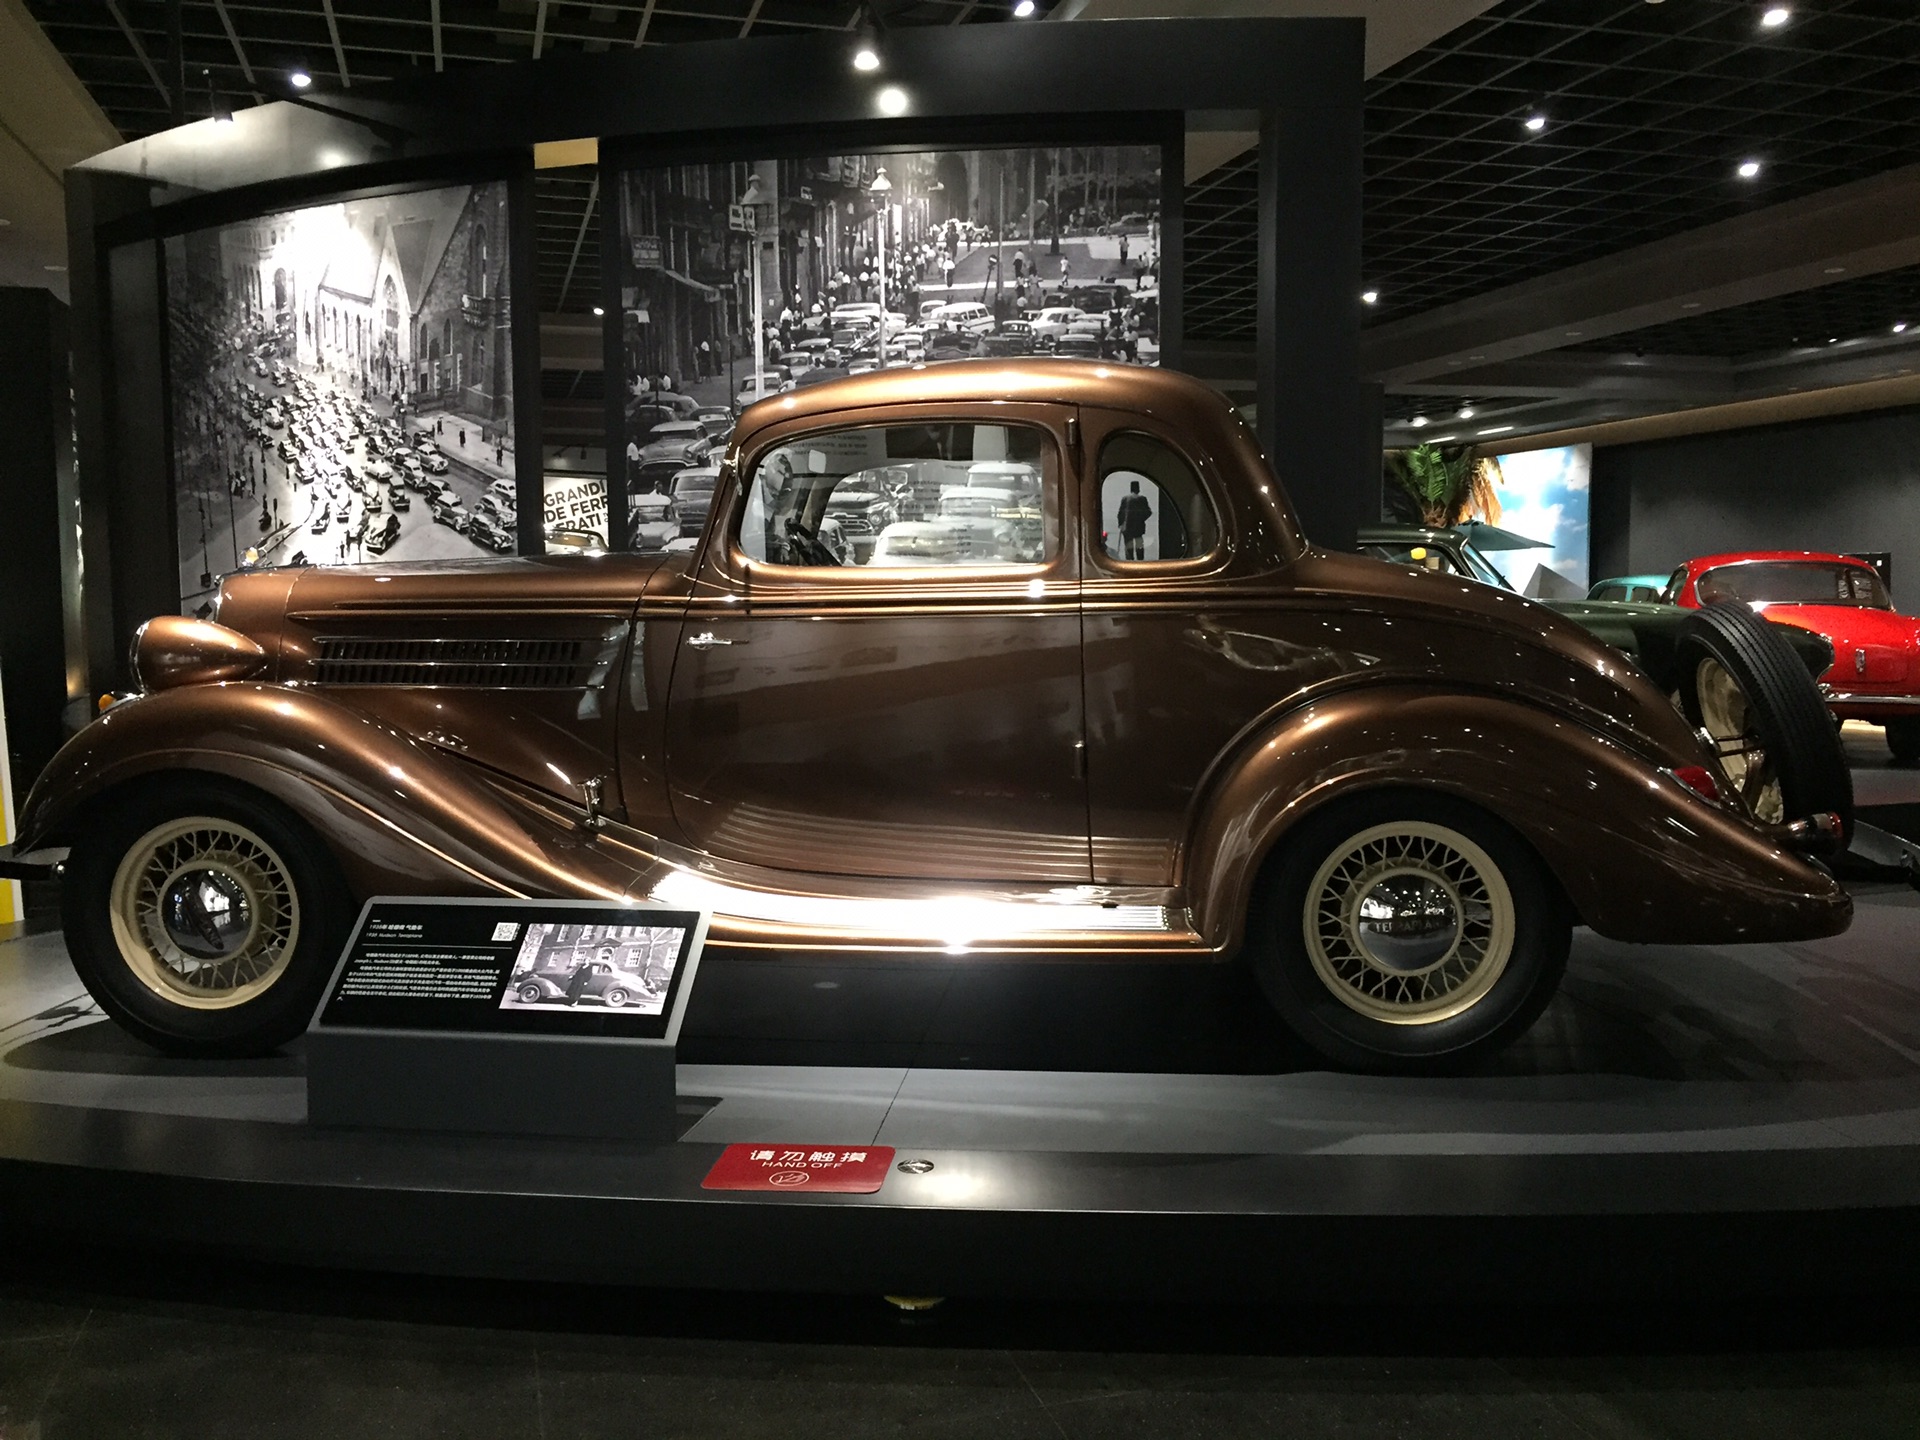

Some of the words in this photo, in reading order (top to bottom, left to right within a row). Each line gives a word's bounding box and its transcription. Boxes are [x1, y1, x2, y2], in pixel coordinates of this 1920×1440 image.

[544, 507, 567, 523] DE
[749, 1149, 868, 1163] 请勿触摸
